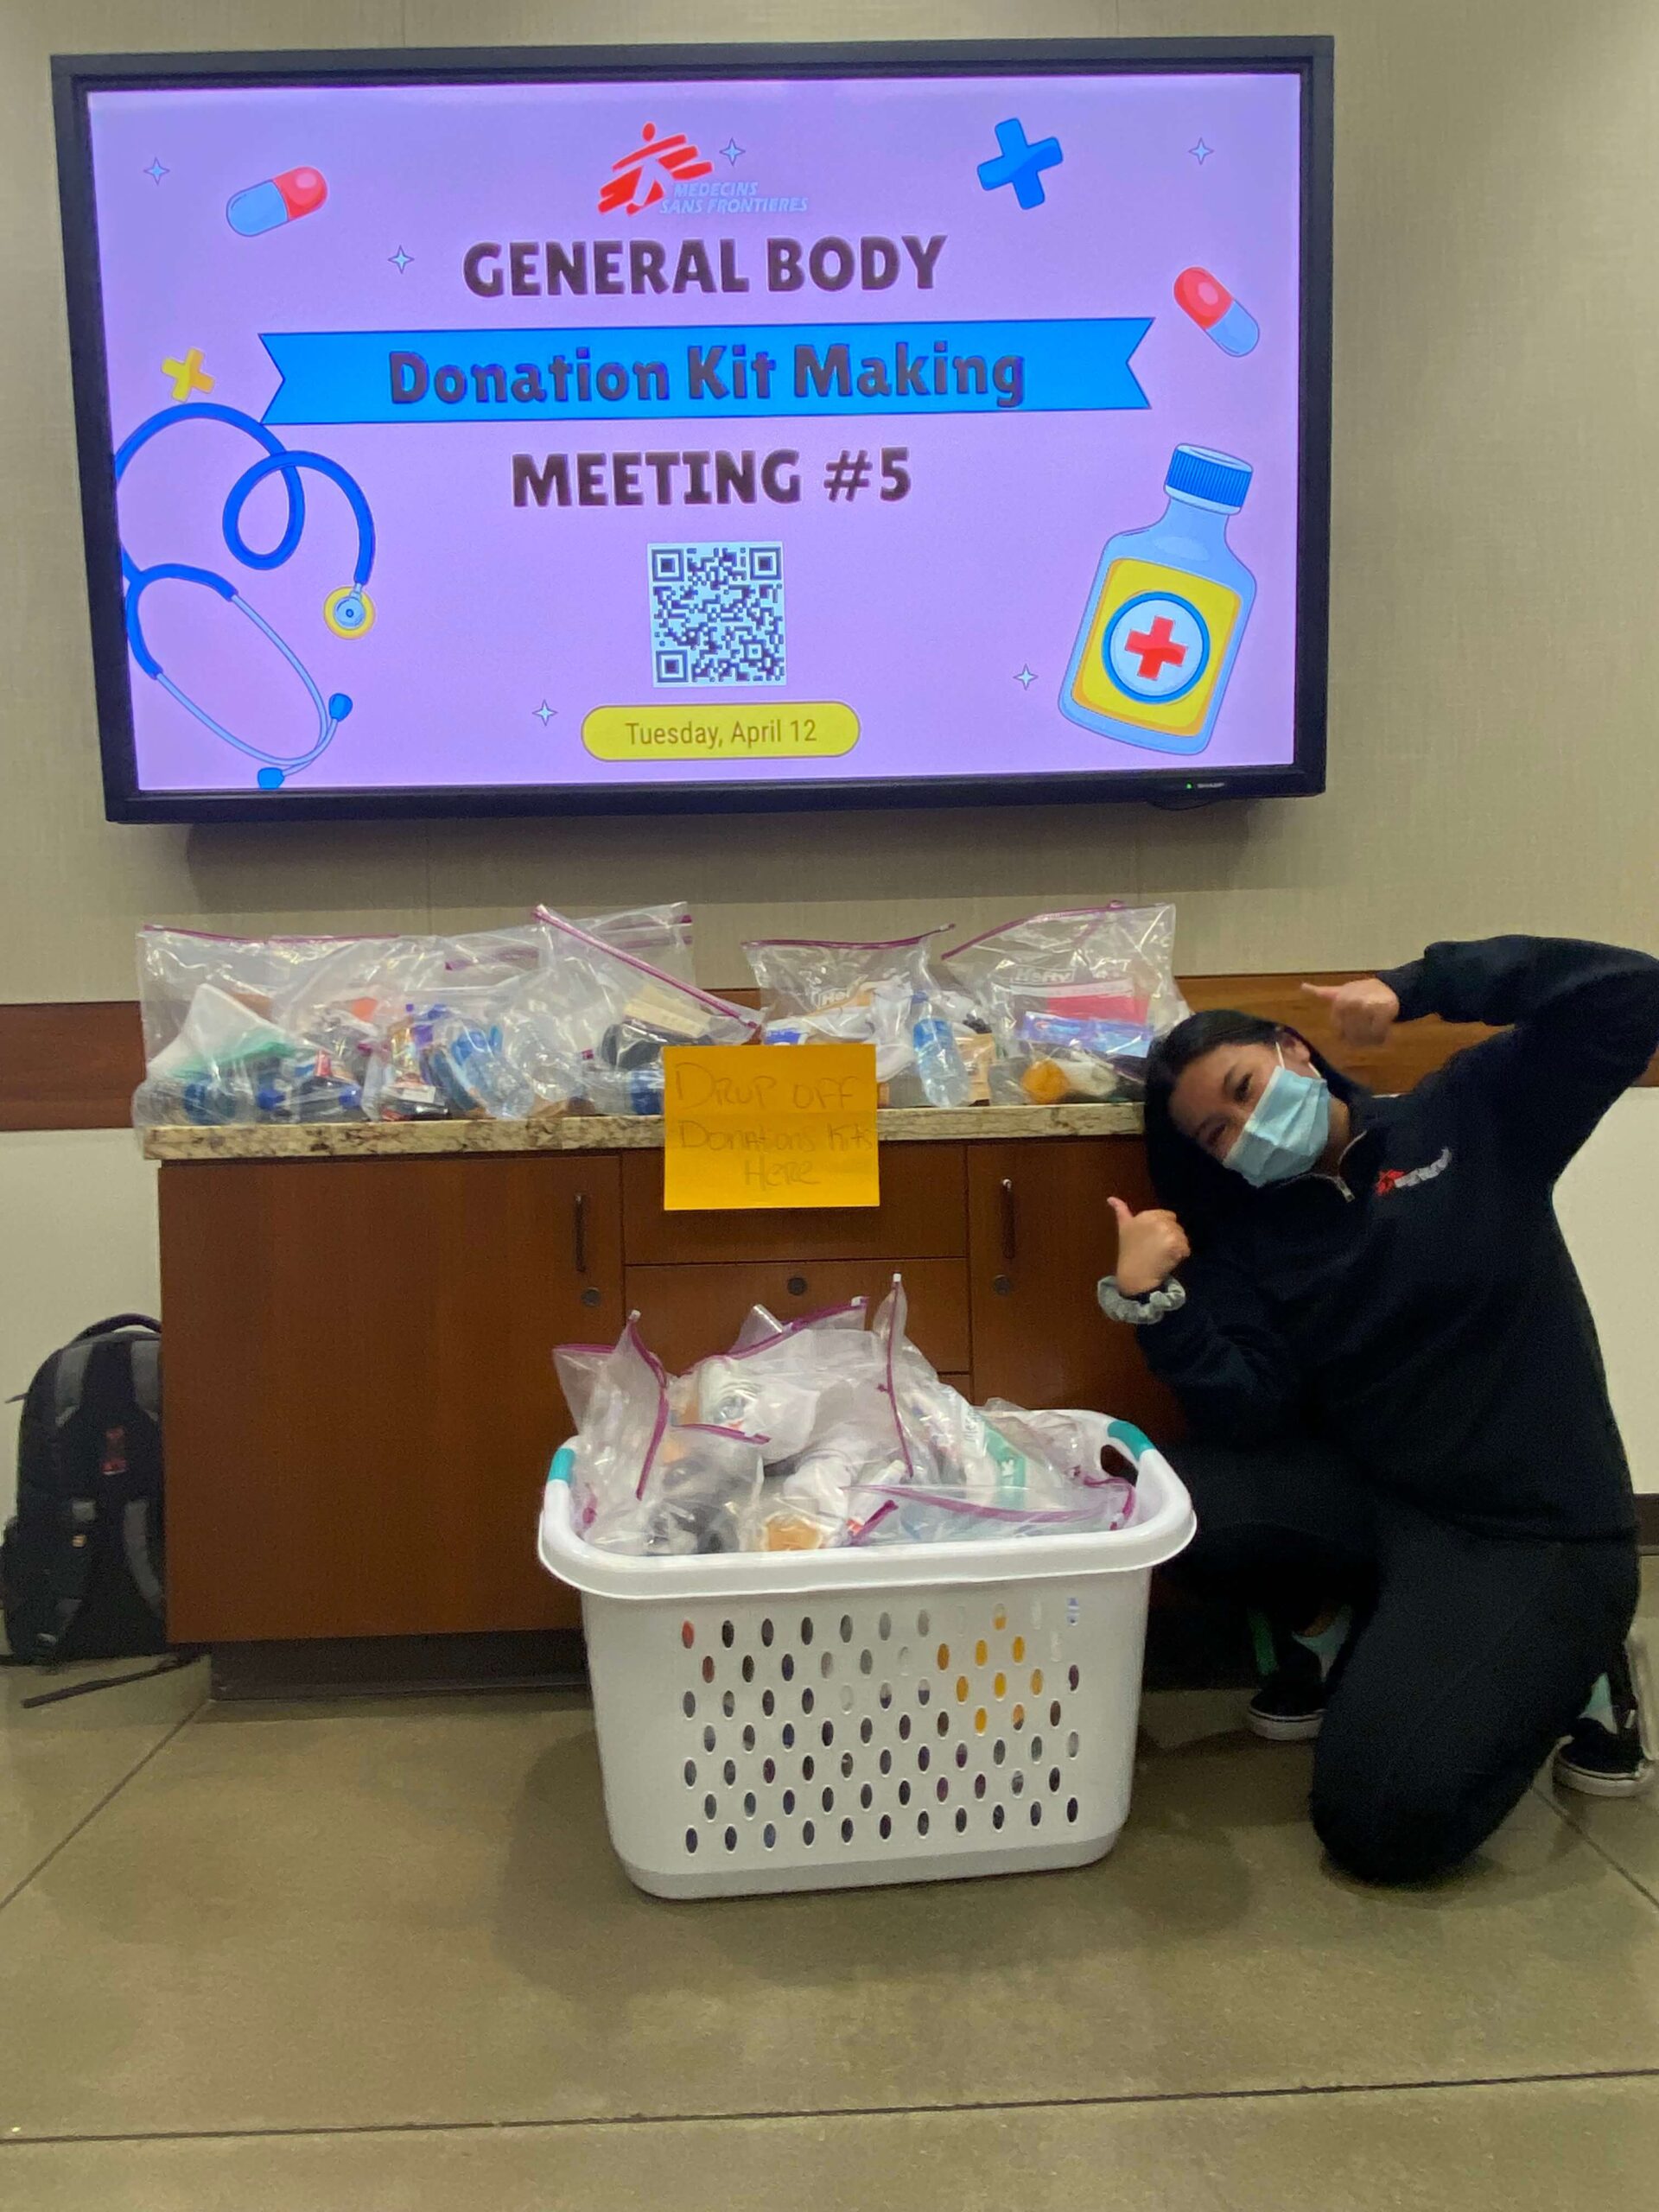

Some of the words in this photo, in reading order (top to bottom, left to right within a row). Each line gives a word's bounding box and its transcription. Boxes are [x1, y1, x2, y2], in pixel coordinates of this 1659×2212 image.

[659, 199, 702, 214] SANS
[707, 197, 809, 213] FRONTIERES
[463, 238, 749, 297] GENERAL
[766, 233, 948, 291] BODY
[389, 346, 671, 404] Donation
[688, 344, 776, 399] Kit
[794, 340, 1026, 408] Making
[512, 449, 802, 507] MEETING
[823, 447, 912, 503] #5
[625, 721, 723, 750] Tuesday,
[730, 719, 782, 748] April
[790, 718, 817, 742] 12
